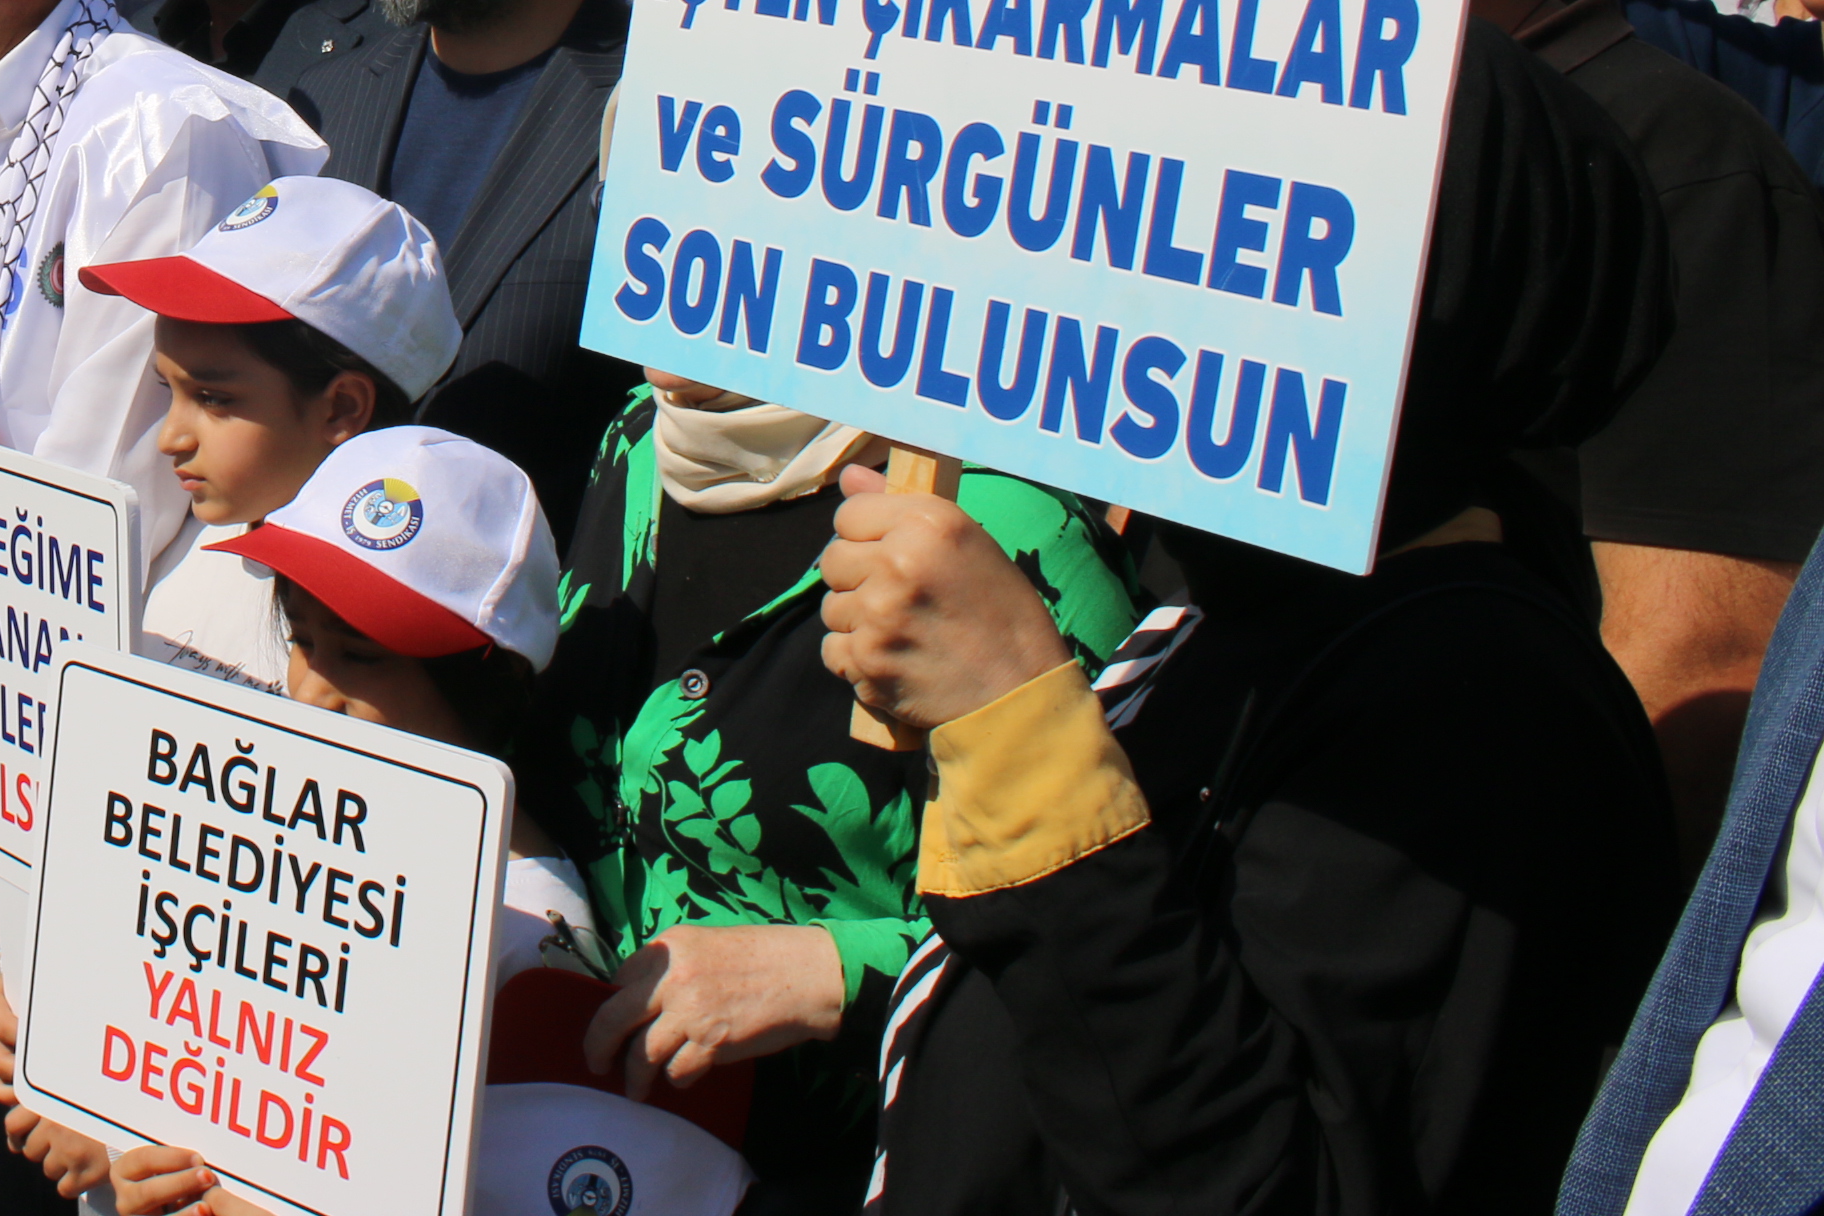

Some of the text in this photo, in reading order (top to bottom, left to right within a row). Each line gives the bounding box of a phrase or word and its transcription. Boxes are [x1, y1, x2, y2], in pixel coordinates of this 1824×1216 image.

[656, 69, 1356, 318] ve SÜRGÜNLER
[614, 216, 1348, 508] SON BULUNSUN
[148, 727, 367, 853] BAĞLAR
[104, 790, 407, 948] BELEDİYESİ
[136, 871, 350, 1014] İŞÇİLERİ
[101, 1024, 352, 1181] DEĞİLDİR
[144, 961, 329, 1088] YALNIZ
